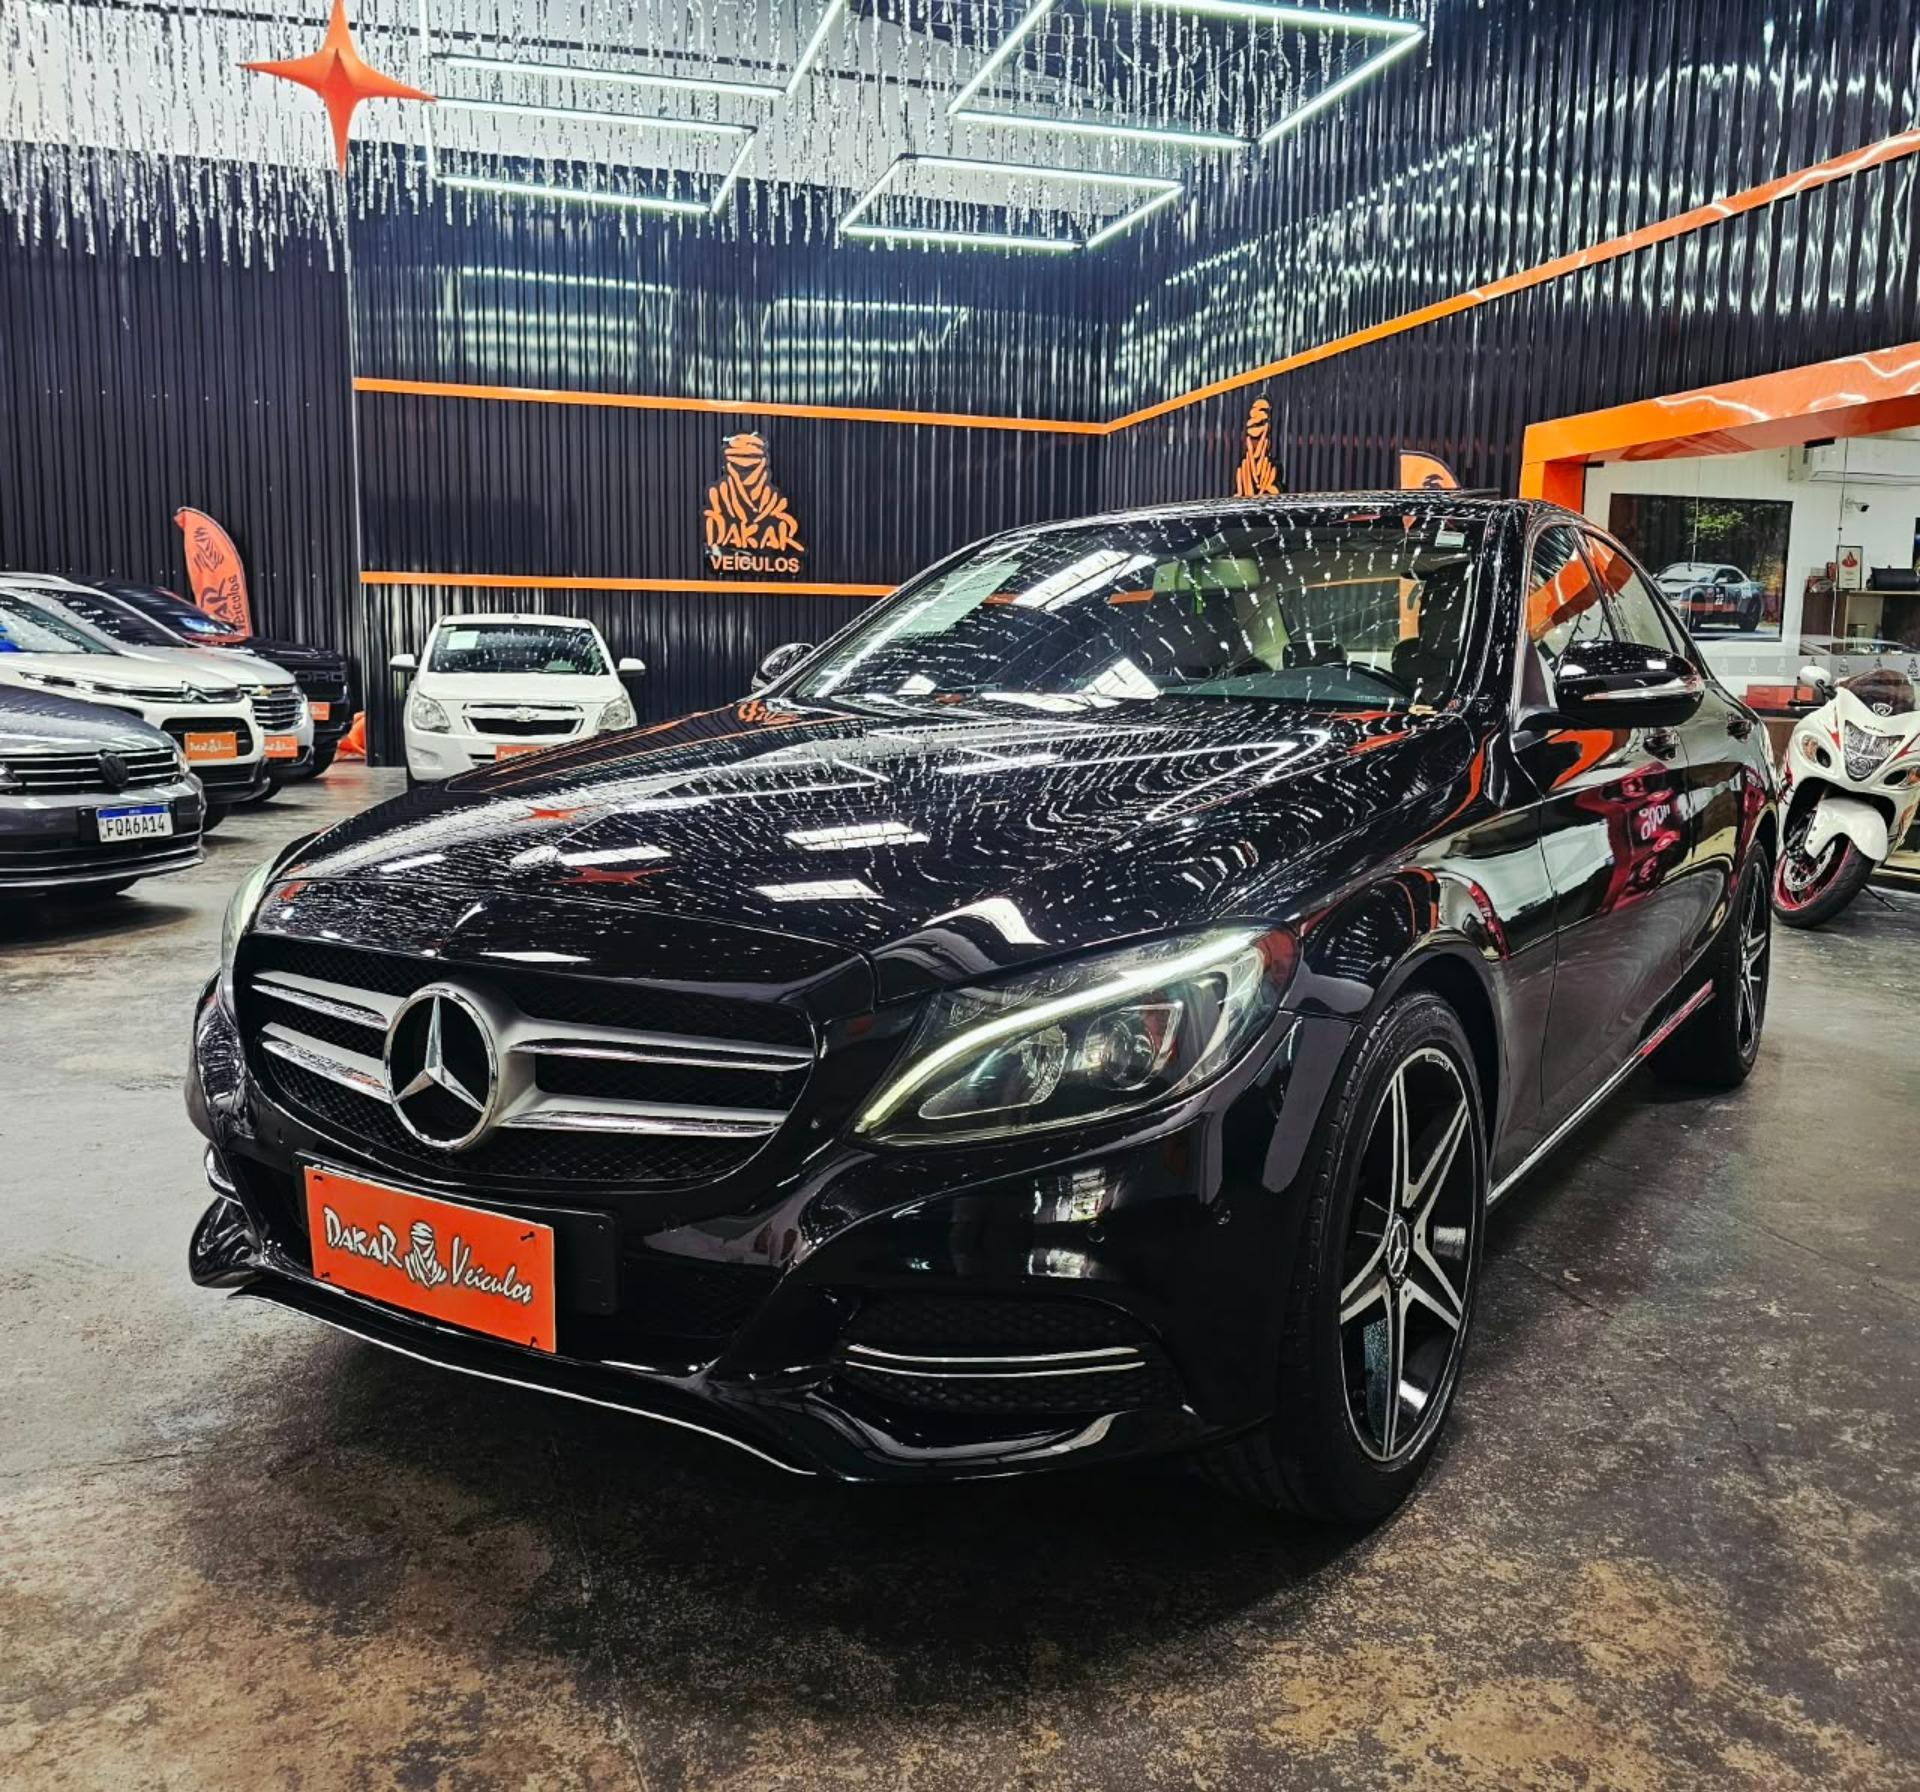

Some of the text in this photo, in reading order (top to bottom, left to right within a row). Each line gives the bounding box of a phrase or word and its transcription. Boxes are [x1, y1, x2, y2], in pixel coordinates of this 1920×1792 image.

[703, 507, 805, 551] DAKAR
[297, 671, 346, 683] ORD
[323, 1206, 533, 1304] DAKAR Veículos
